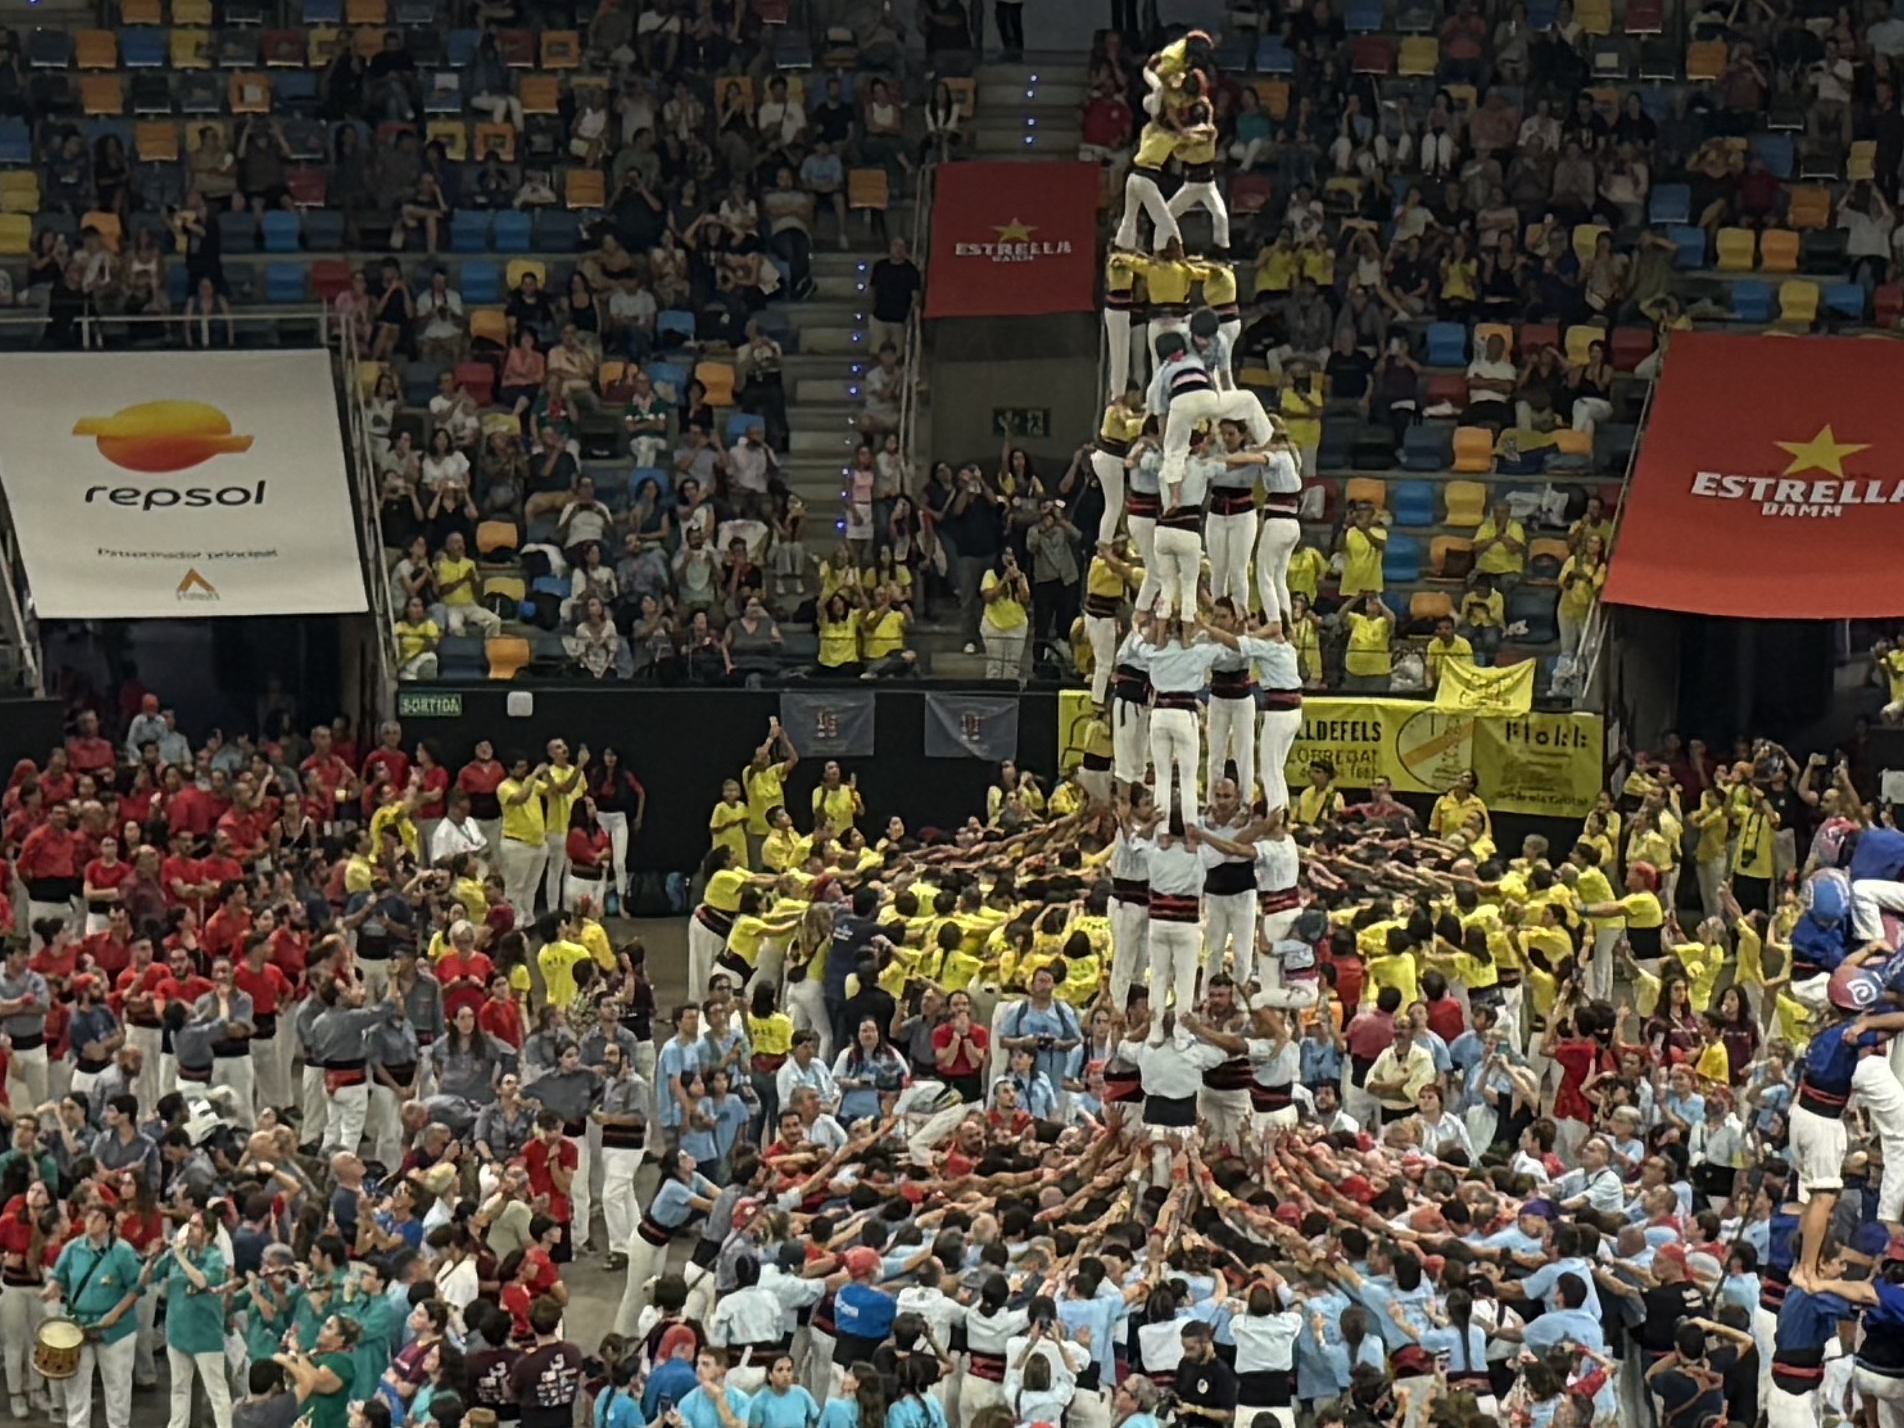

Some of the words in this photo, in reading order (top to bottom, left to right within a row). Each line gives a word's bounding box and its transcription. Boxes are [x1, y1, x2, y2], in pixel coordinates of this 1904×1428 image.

[954, 240, 1072, 257] ESTRELLA
[84, 480, 267, 511] repsol
[1761, 501, 1844, 519] DAMM
[401, 696, 460, 714] SORTIDA
